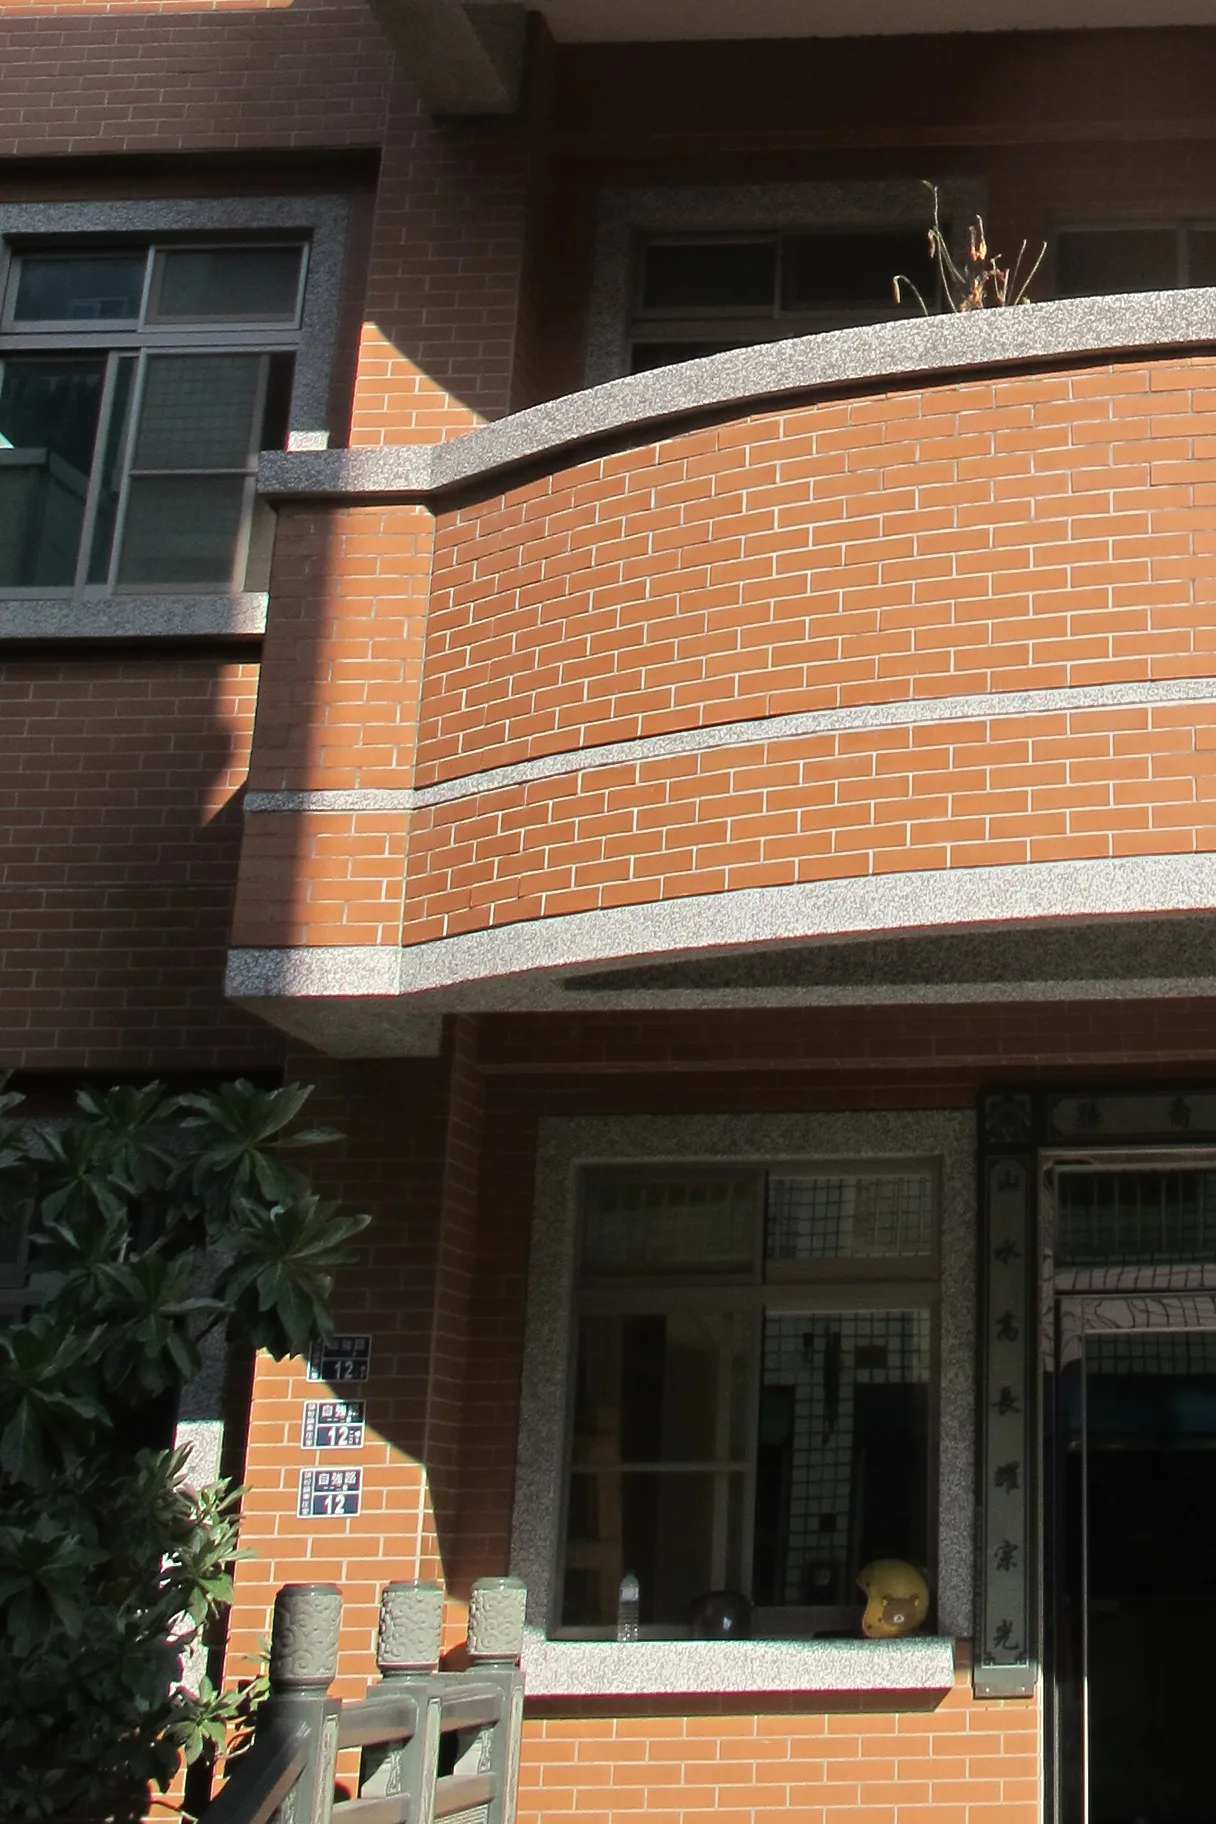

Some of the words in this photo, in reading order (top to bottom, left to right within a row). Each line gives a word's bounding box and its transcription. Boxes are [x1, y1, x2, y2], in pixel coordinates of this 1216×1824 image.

[334, 1360, 354, 1380] 12
[328, 1426, 349, 1447] 12
[324, 1494, 346, 1515] 12
